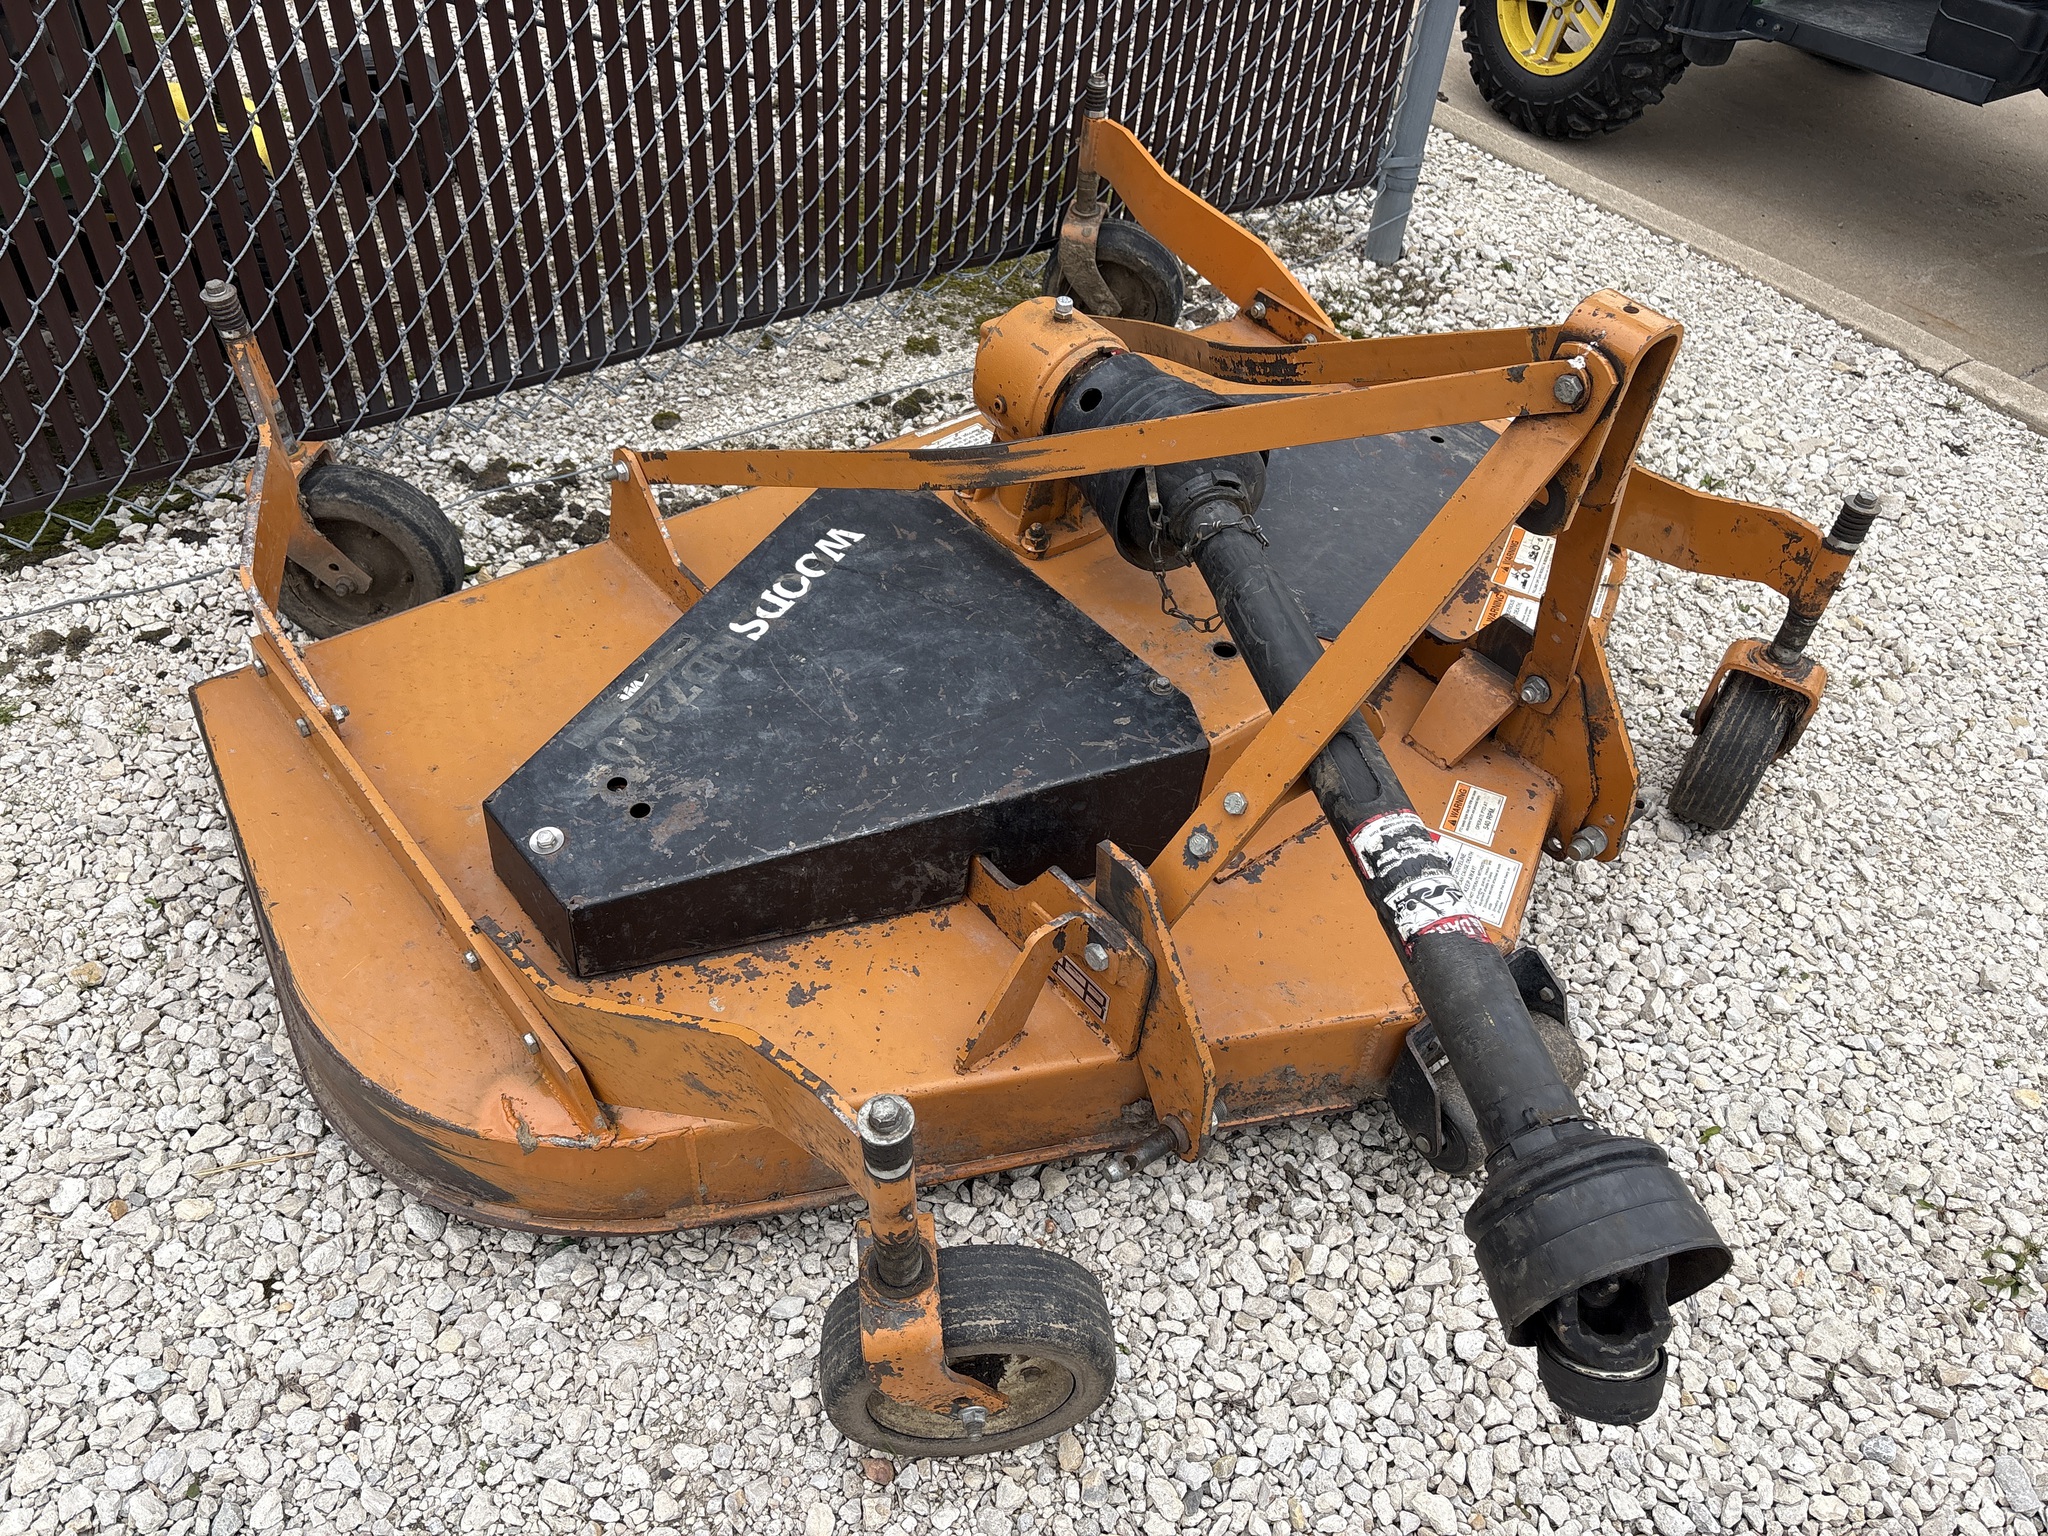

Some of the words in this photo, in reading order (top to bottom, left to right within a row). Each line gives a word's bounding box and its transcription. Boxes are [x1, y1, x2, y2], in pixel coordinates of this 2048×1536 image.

[729, 527, 866, 641] WOODS
[1487, 593, 1504, 622] WARNING
[1453, 788, 1467, 818] WARNING
[1474, 813, 1484, 830] OPERATE
[1482, 820, 1491, 830] 540
[1460, 863, 1469, 876] CAUSE
[1465, 850, 1474, 864] DEATH
[1462, 880, 1471, 892] KEEP
